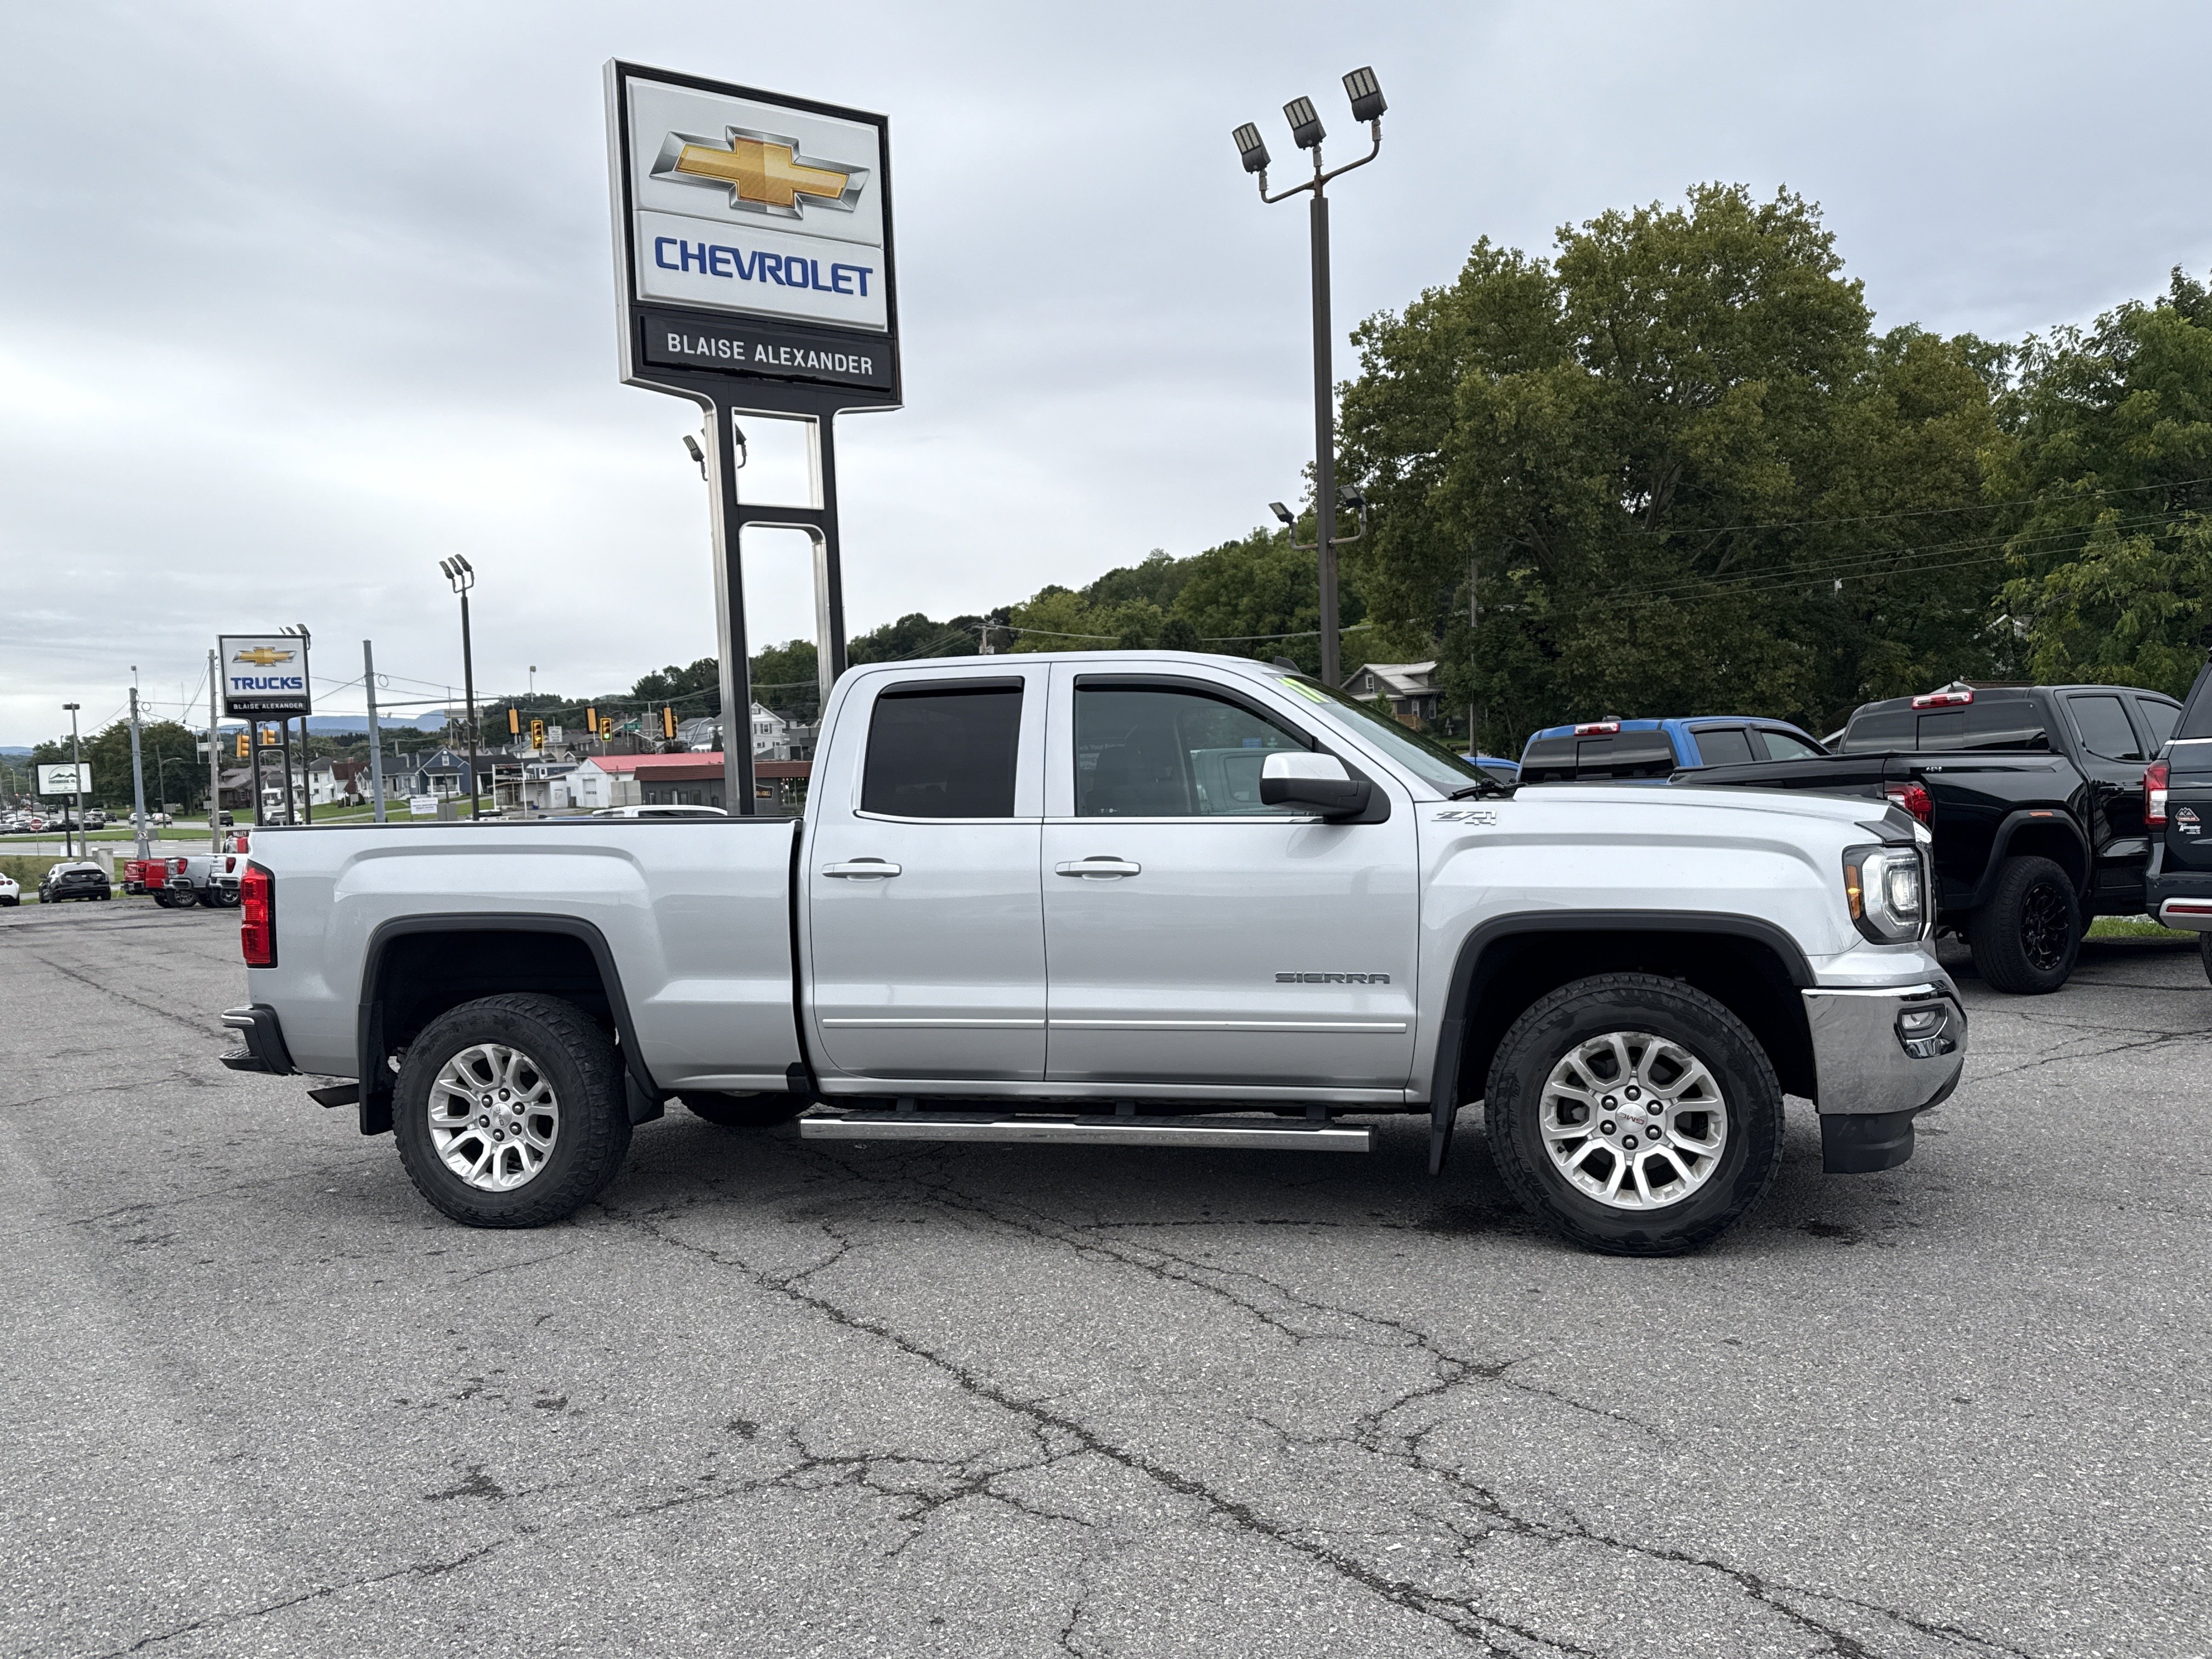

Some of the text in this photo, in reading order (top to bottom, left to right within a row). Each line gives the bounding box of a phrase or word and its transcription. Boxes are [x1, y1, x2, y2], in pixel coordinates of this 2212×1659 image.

[654, 236, 873, 297] CHEVROLET
[667, 333, 873, 375] BLAISE ALEXANDER
[230, 677, 303, 690] TRUCKS
[1275, 972, 1390, 984] SIERRA
[496, 1105, 505, 1126] GMC
[1619, 1112, 1645, 1125] GMC
